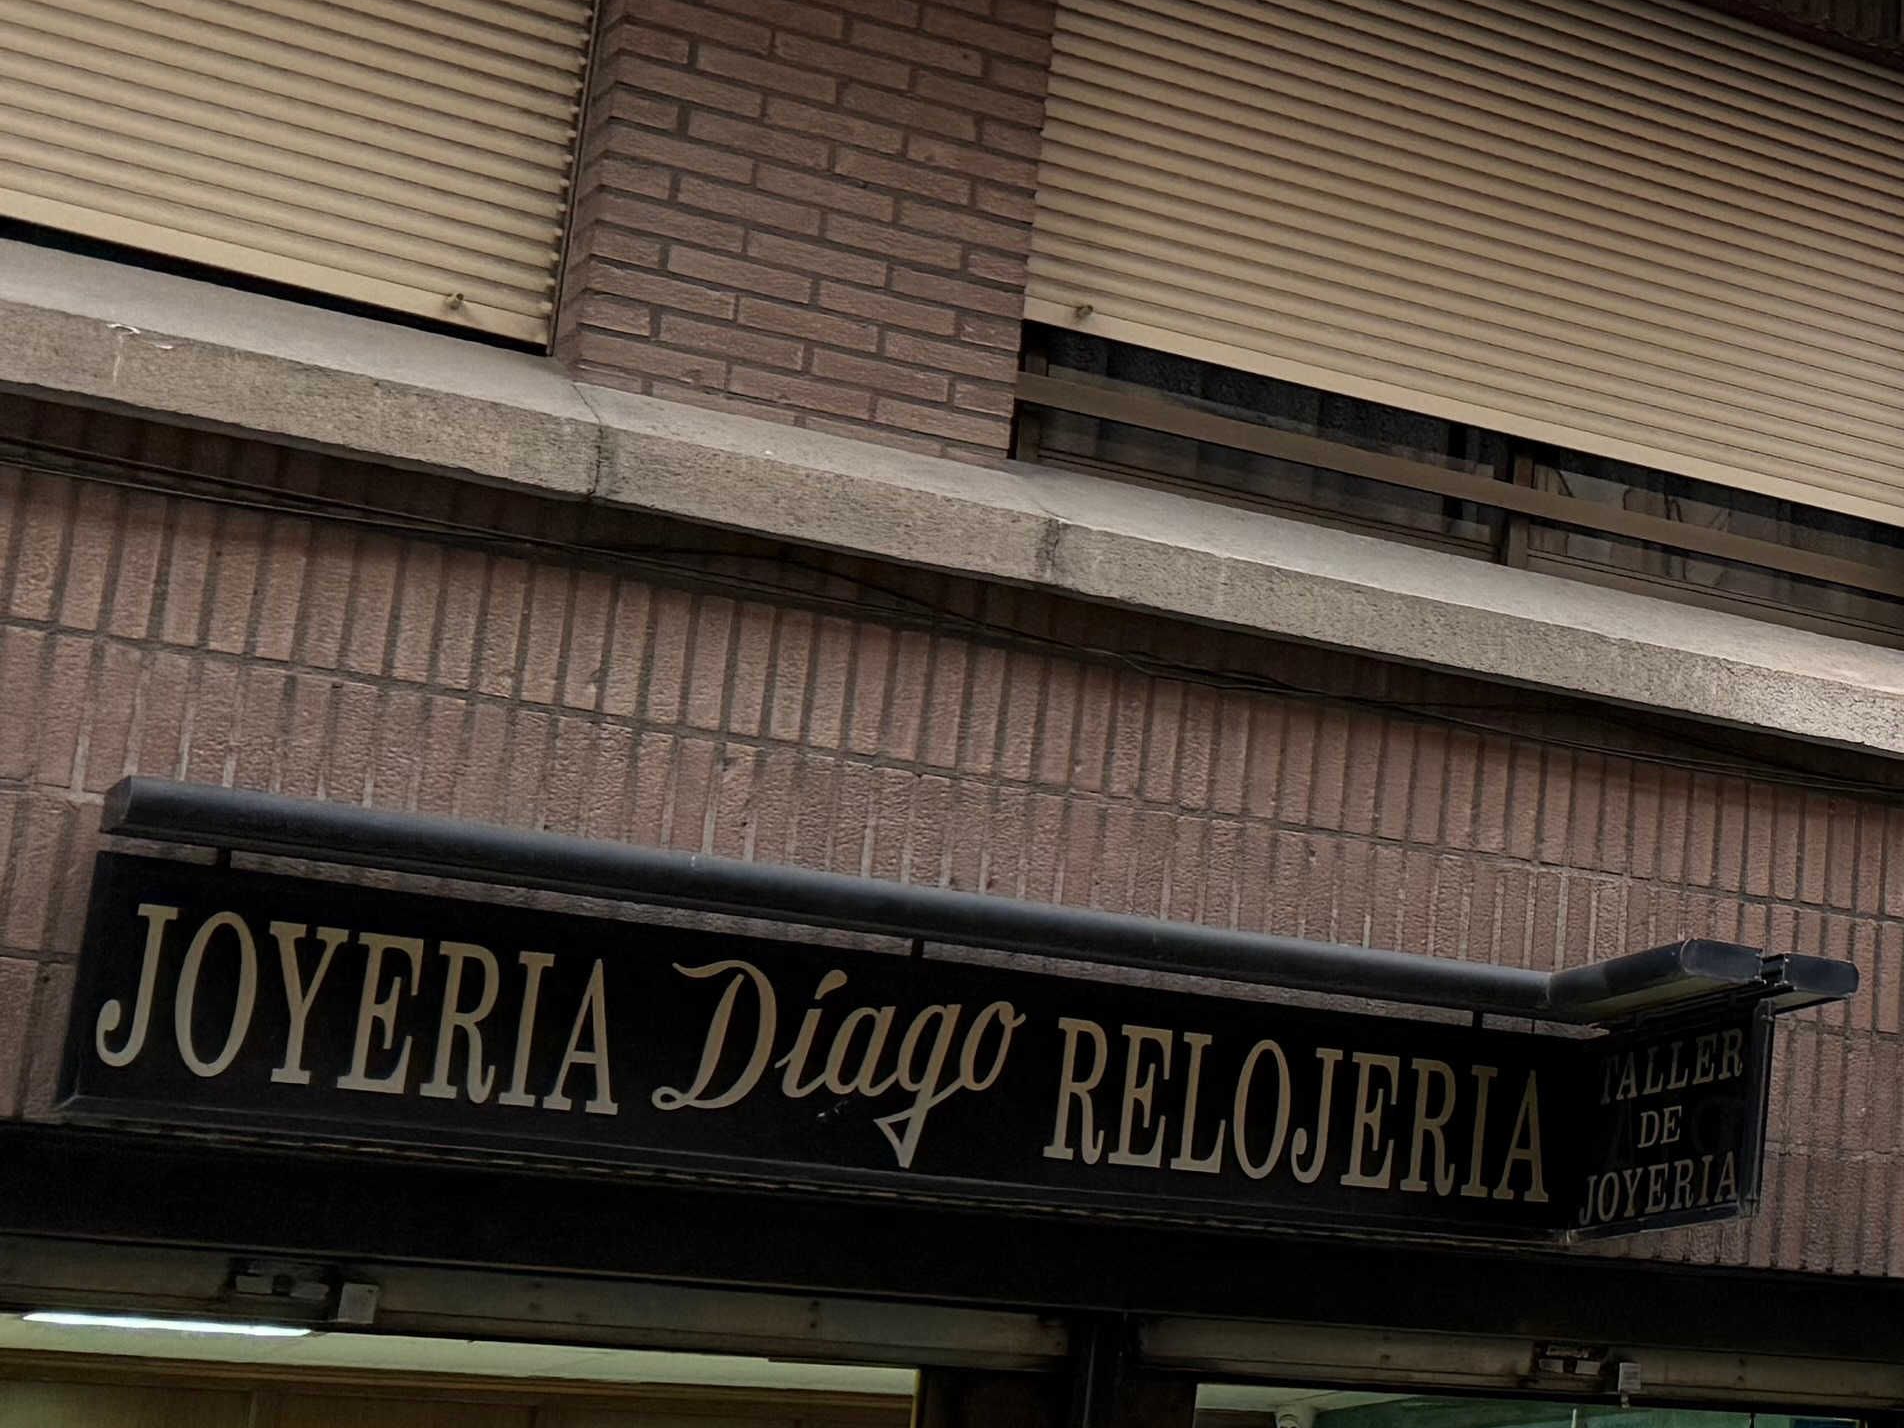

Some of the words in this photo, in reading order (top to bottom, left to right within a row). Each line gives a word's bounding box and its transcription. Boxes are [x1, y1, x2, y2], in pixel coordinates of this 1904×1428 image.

[94, 903, 620, 1117] JOYERIA
[1042, 1016, 1550, 1203] RELOJERIA
[1598, 1028, 1746, 1105] TALLER
[1637, 1104, 1683, 1149] DE
[1578, 1148, 1740, 1227] JOYERIA
